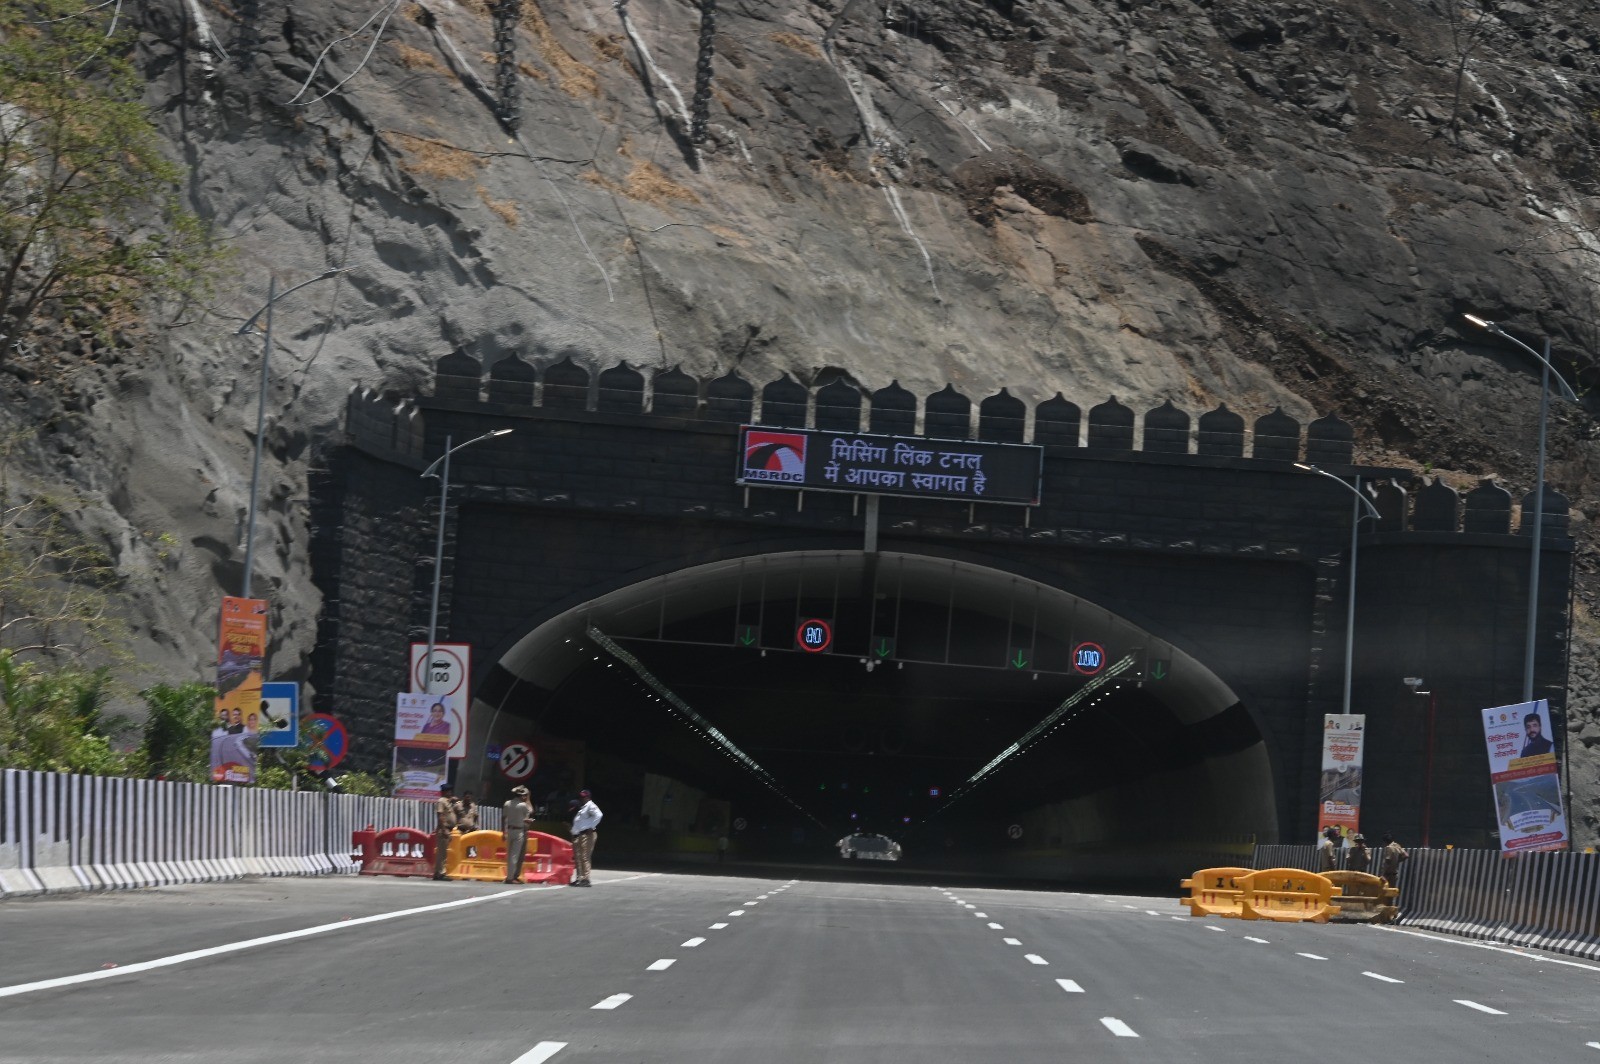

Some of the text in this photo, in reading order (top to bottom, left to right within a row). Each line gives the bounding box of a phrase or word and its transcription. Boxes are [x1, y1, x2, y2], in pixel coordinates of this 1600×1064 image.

[830, 437, 983, 470] मिसिंग लिंक टनल
[744, 469, 803, 482] MSRDC
[823, 460, 987, 495] में आपका स्वागत है
[429, 672, 450, 682] 100
